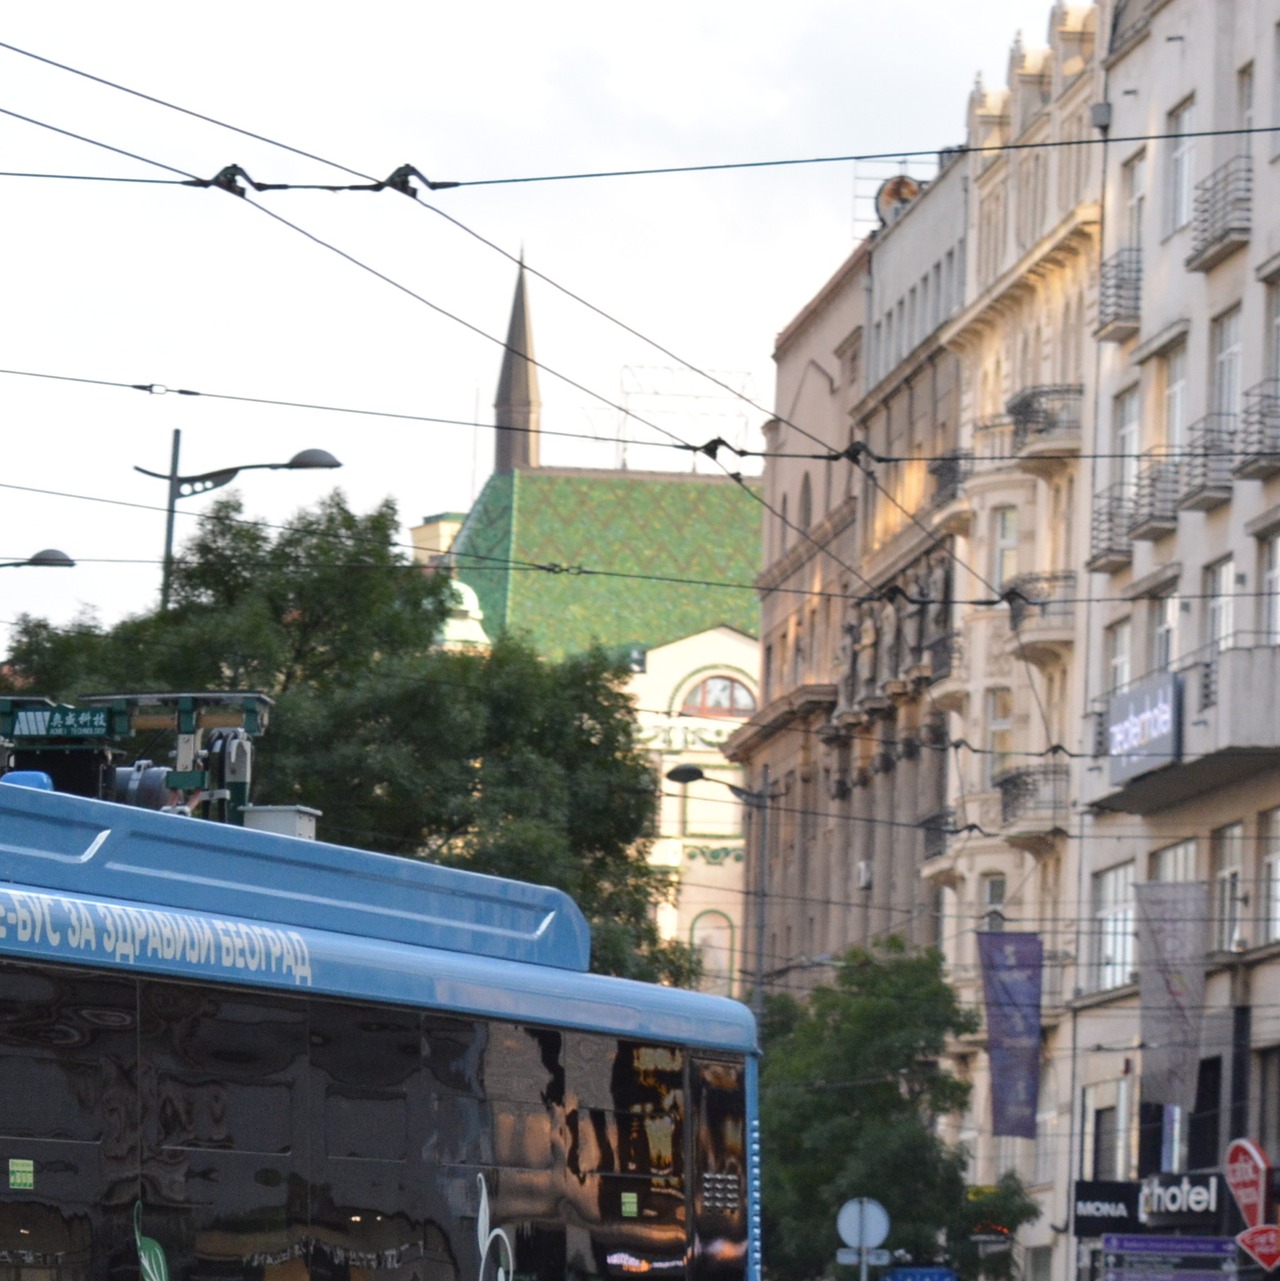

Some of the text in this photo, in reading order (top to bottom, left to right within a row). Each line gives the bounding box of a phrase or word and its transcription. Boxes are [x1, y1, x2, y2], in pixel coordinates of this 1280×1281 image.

[63, 901, 96, 951] ЗА
[212, 919, 312, 986] БЕОГРАД
[1076, 1201, 1128, 1218] MONA
